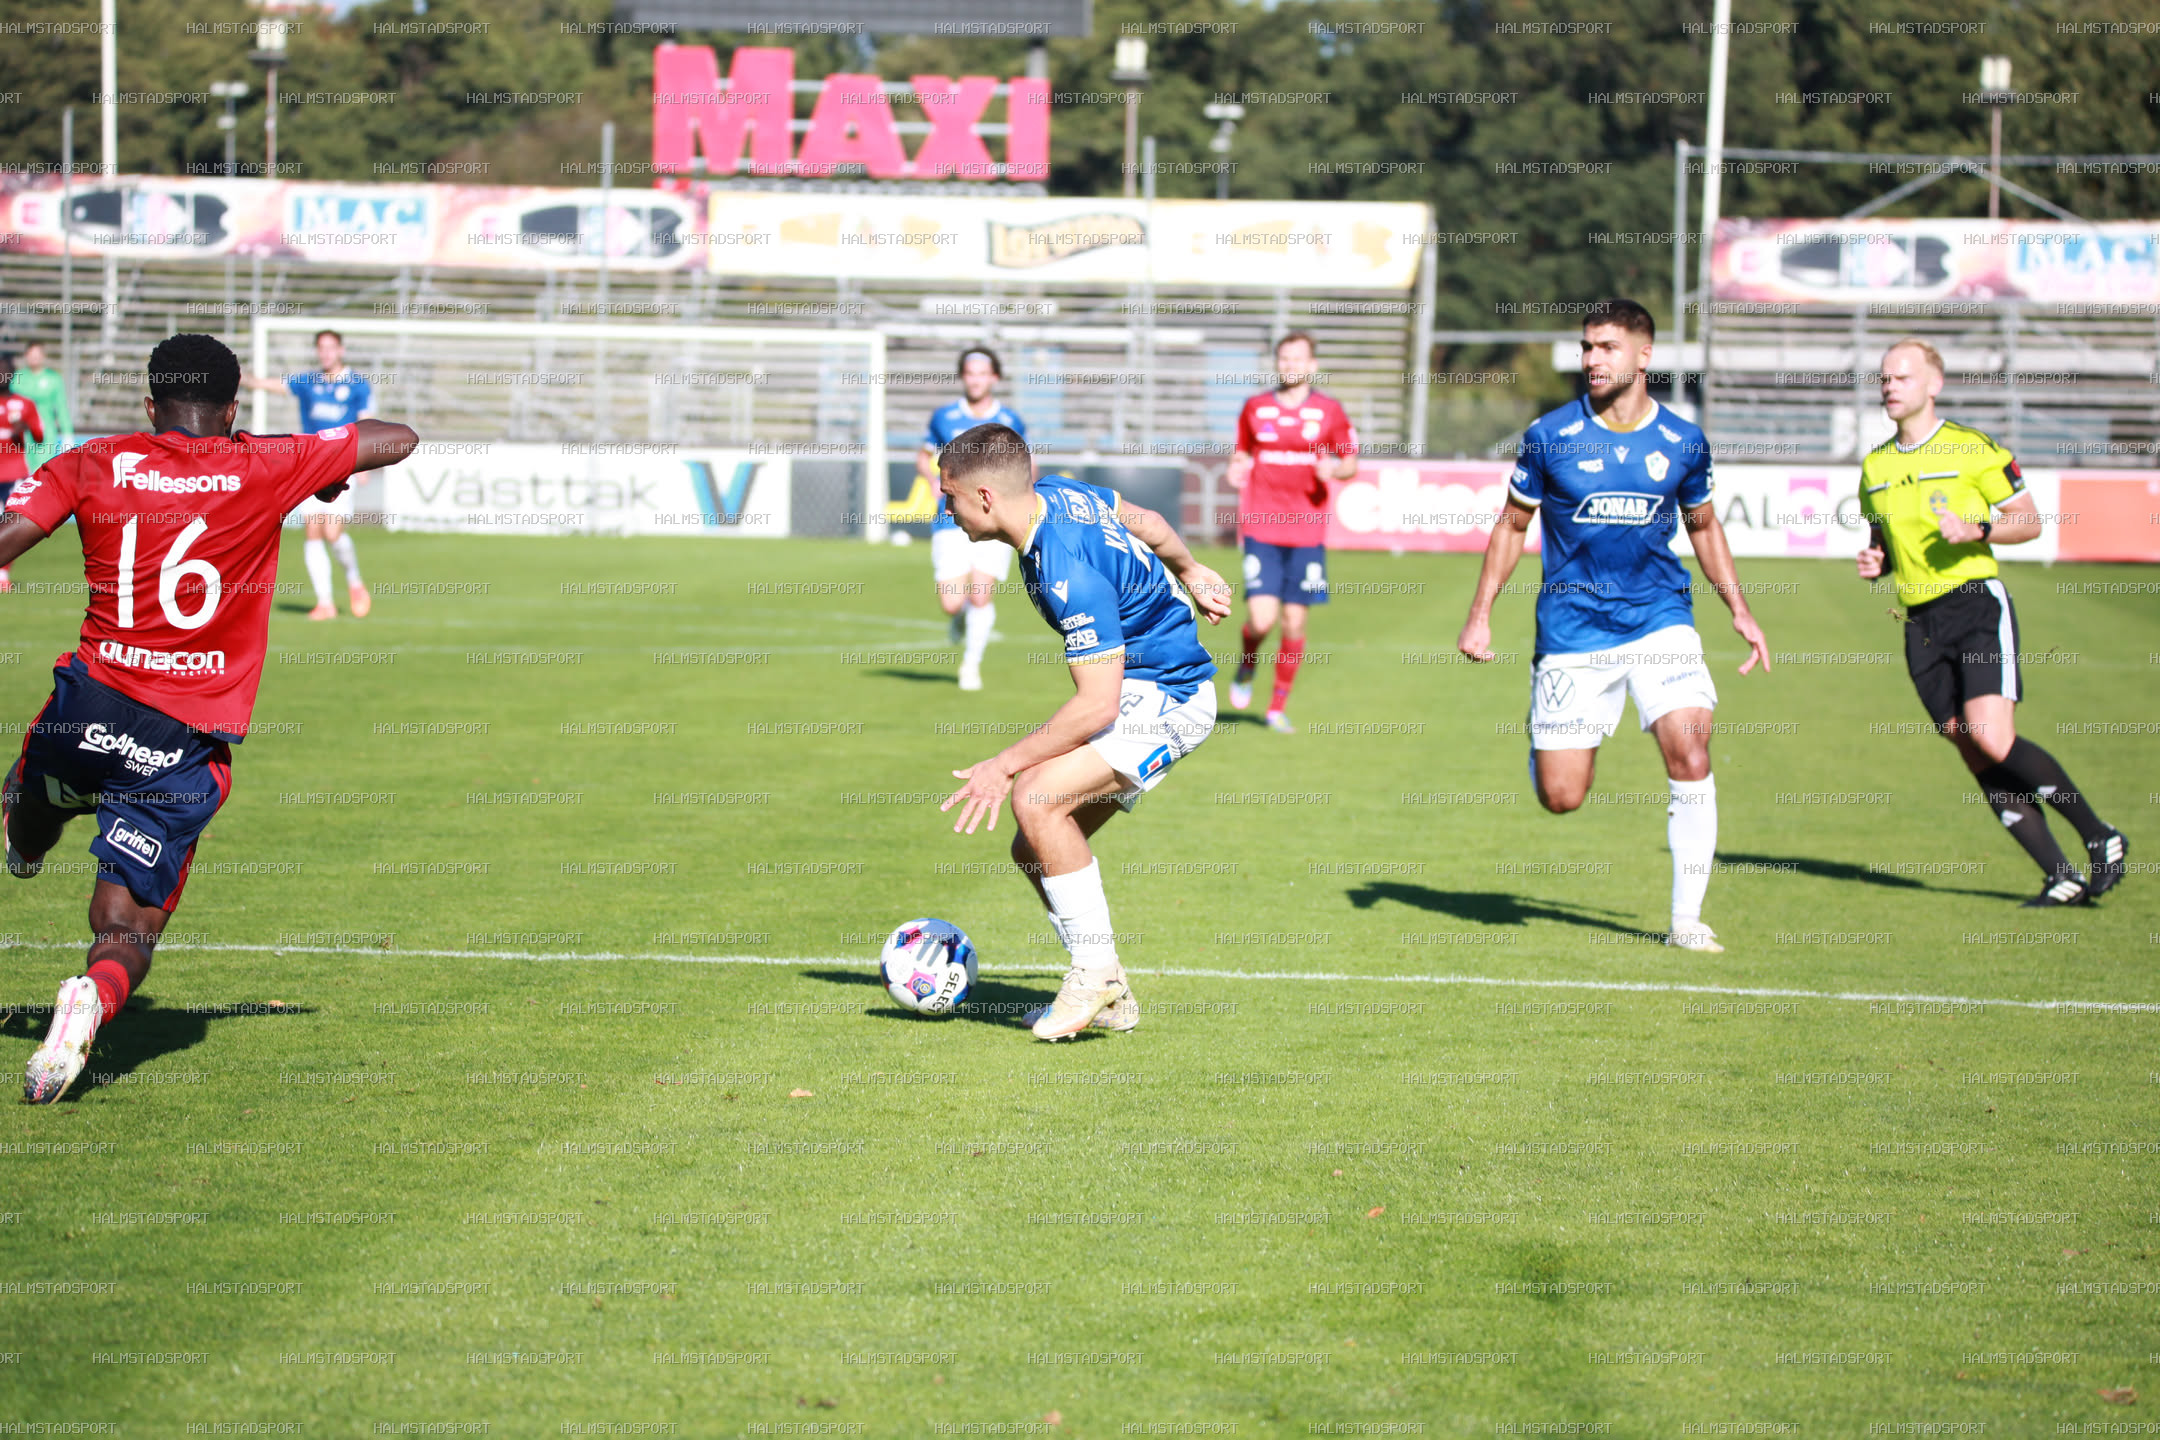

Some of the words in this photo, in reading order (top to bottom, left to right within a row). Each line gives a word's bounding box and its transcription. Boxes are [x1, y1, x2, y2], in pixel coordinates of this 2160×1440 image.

[653, 45, 1050, 181] MAXI
[117, 460, 241, 494] Fellessons
[407, 469, 657, 509] Västtak
[118, 514, 221, 630] 16
[84, 723, 184, 768] GoAhead
[114, 827, 156, 857] griffel
[928, 971, 960, 1013] SELECT
